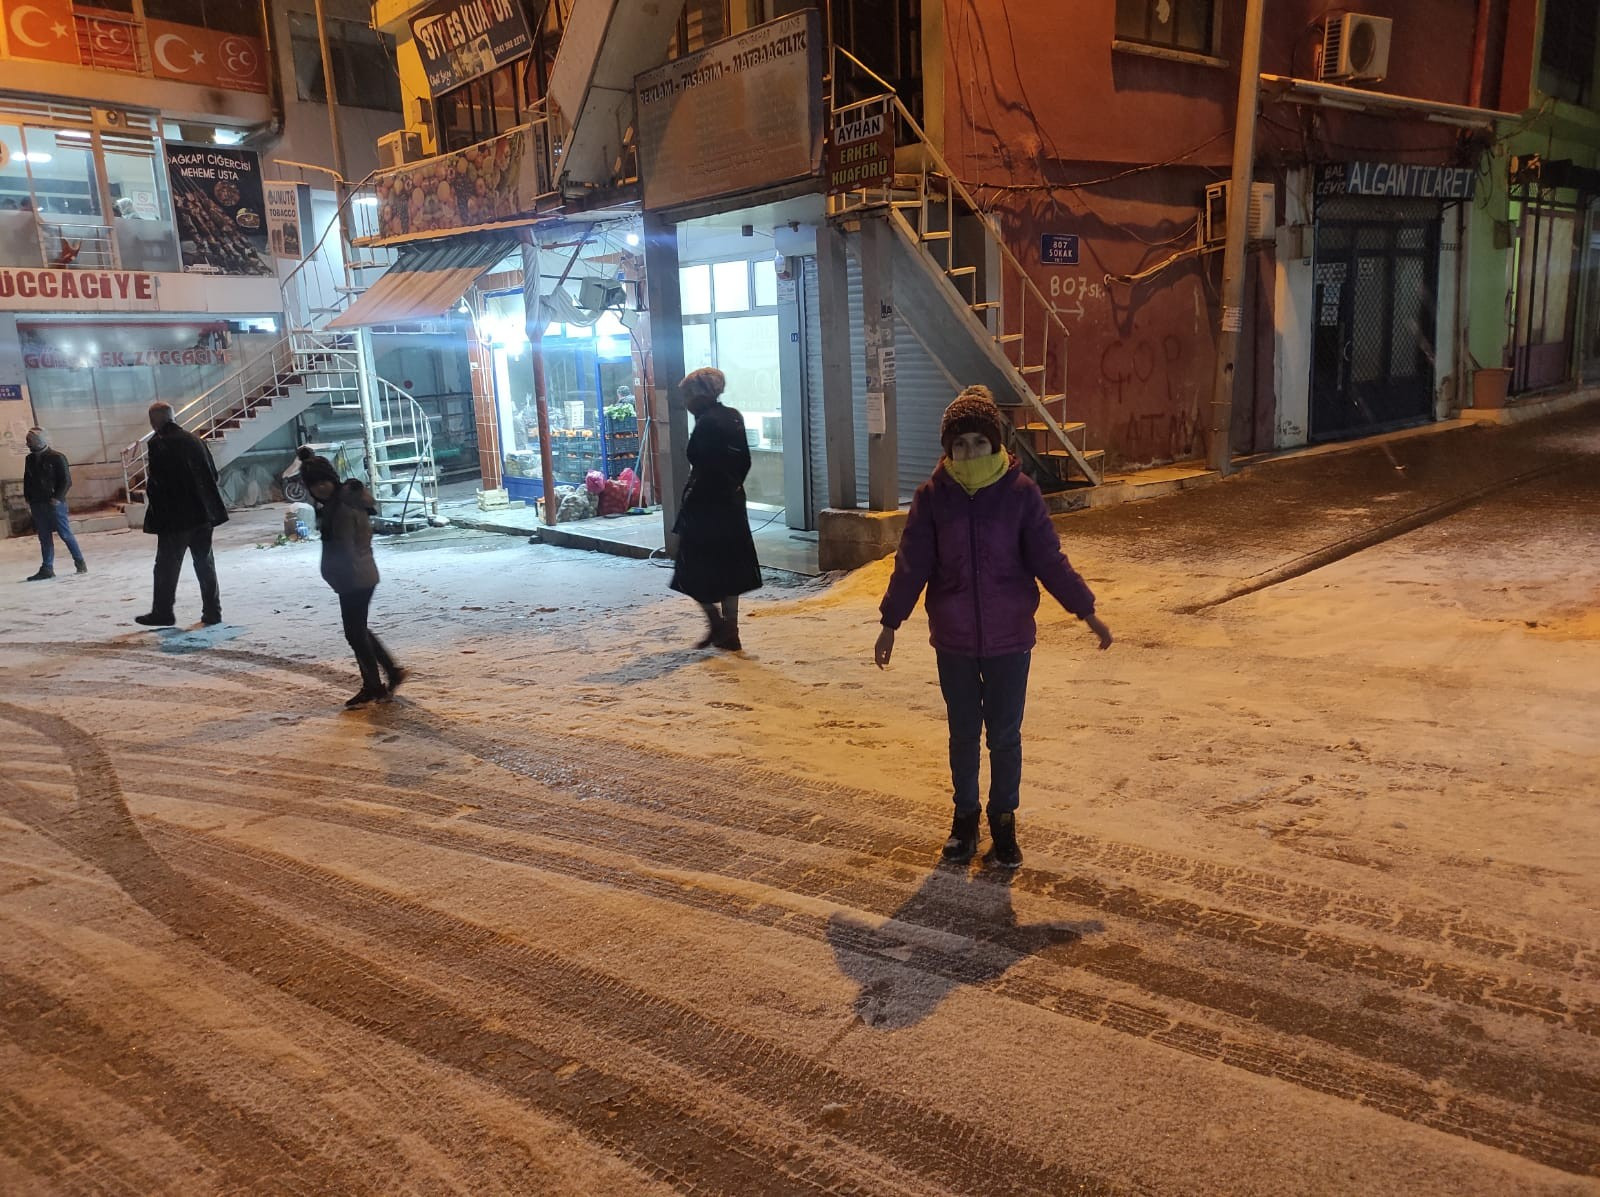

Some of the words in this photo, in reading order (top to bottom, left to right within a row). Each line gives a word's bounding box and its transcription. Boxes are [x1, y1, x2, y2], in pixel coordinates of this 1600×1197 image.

[640, 79, 673, 105] REKLAM
[681, 61, 724, 92] TASARIM
[732, 31, 807, 74] MATBAACILIK
[838, 118, 880, 144] AYHAN
[841, 141, 878, 164] ERKEK
[181, 168, 216, 179] MEHEME
[217, 170, 239, 181] USTA
[832, 157, 888, 186] KUAFÖRÜ
[1324, 165, 1345, 179] BAL
[1348, 161, 1409, 197] ALGAN
[269, 208, 296, 218] TOBACCO
[1049, 249, 1073, 258] SOKAK
[1053, 241, 1068, 249] 807
